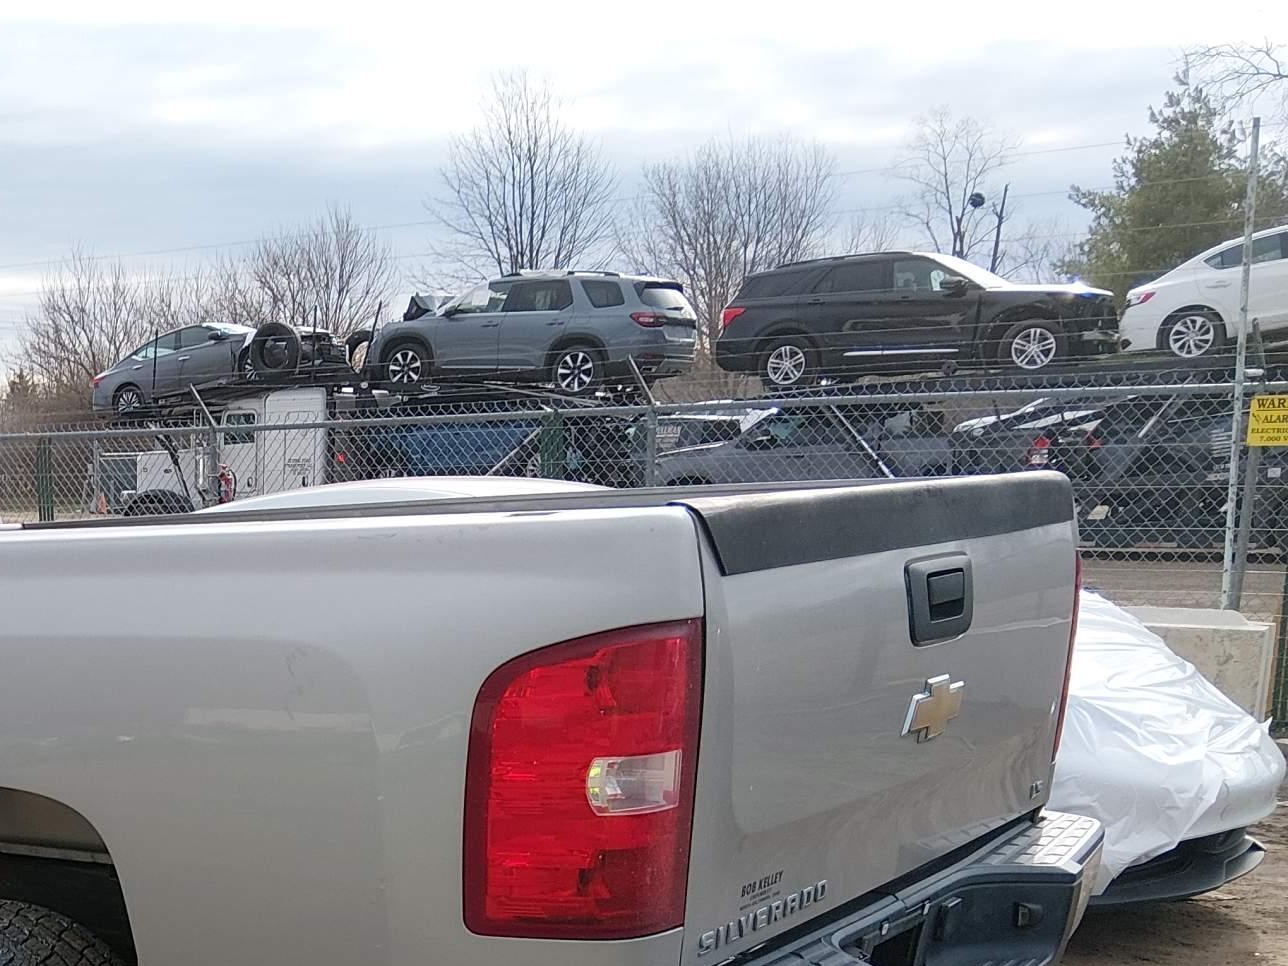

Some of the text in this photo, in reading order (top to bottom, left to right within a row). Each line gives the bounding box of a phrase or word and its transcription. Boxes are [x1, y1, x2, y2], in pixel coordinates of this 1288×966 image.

[1257, 398, 1288, 409] WAR
[1262, 414, 1288, 424] ALAR
[741, 880, 757, 898] BOB
[757, 870, 784, 891] KELLEY
[697, 879, 827, 957] SILVERADO
